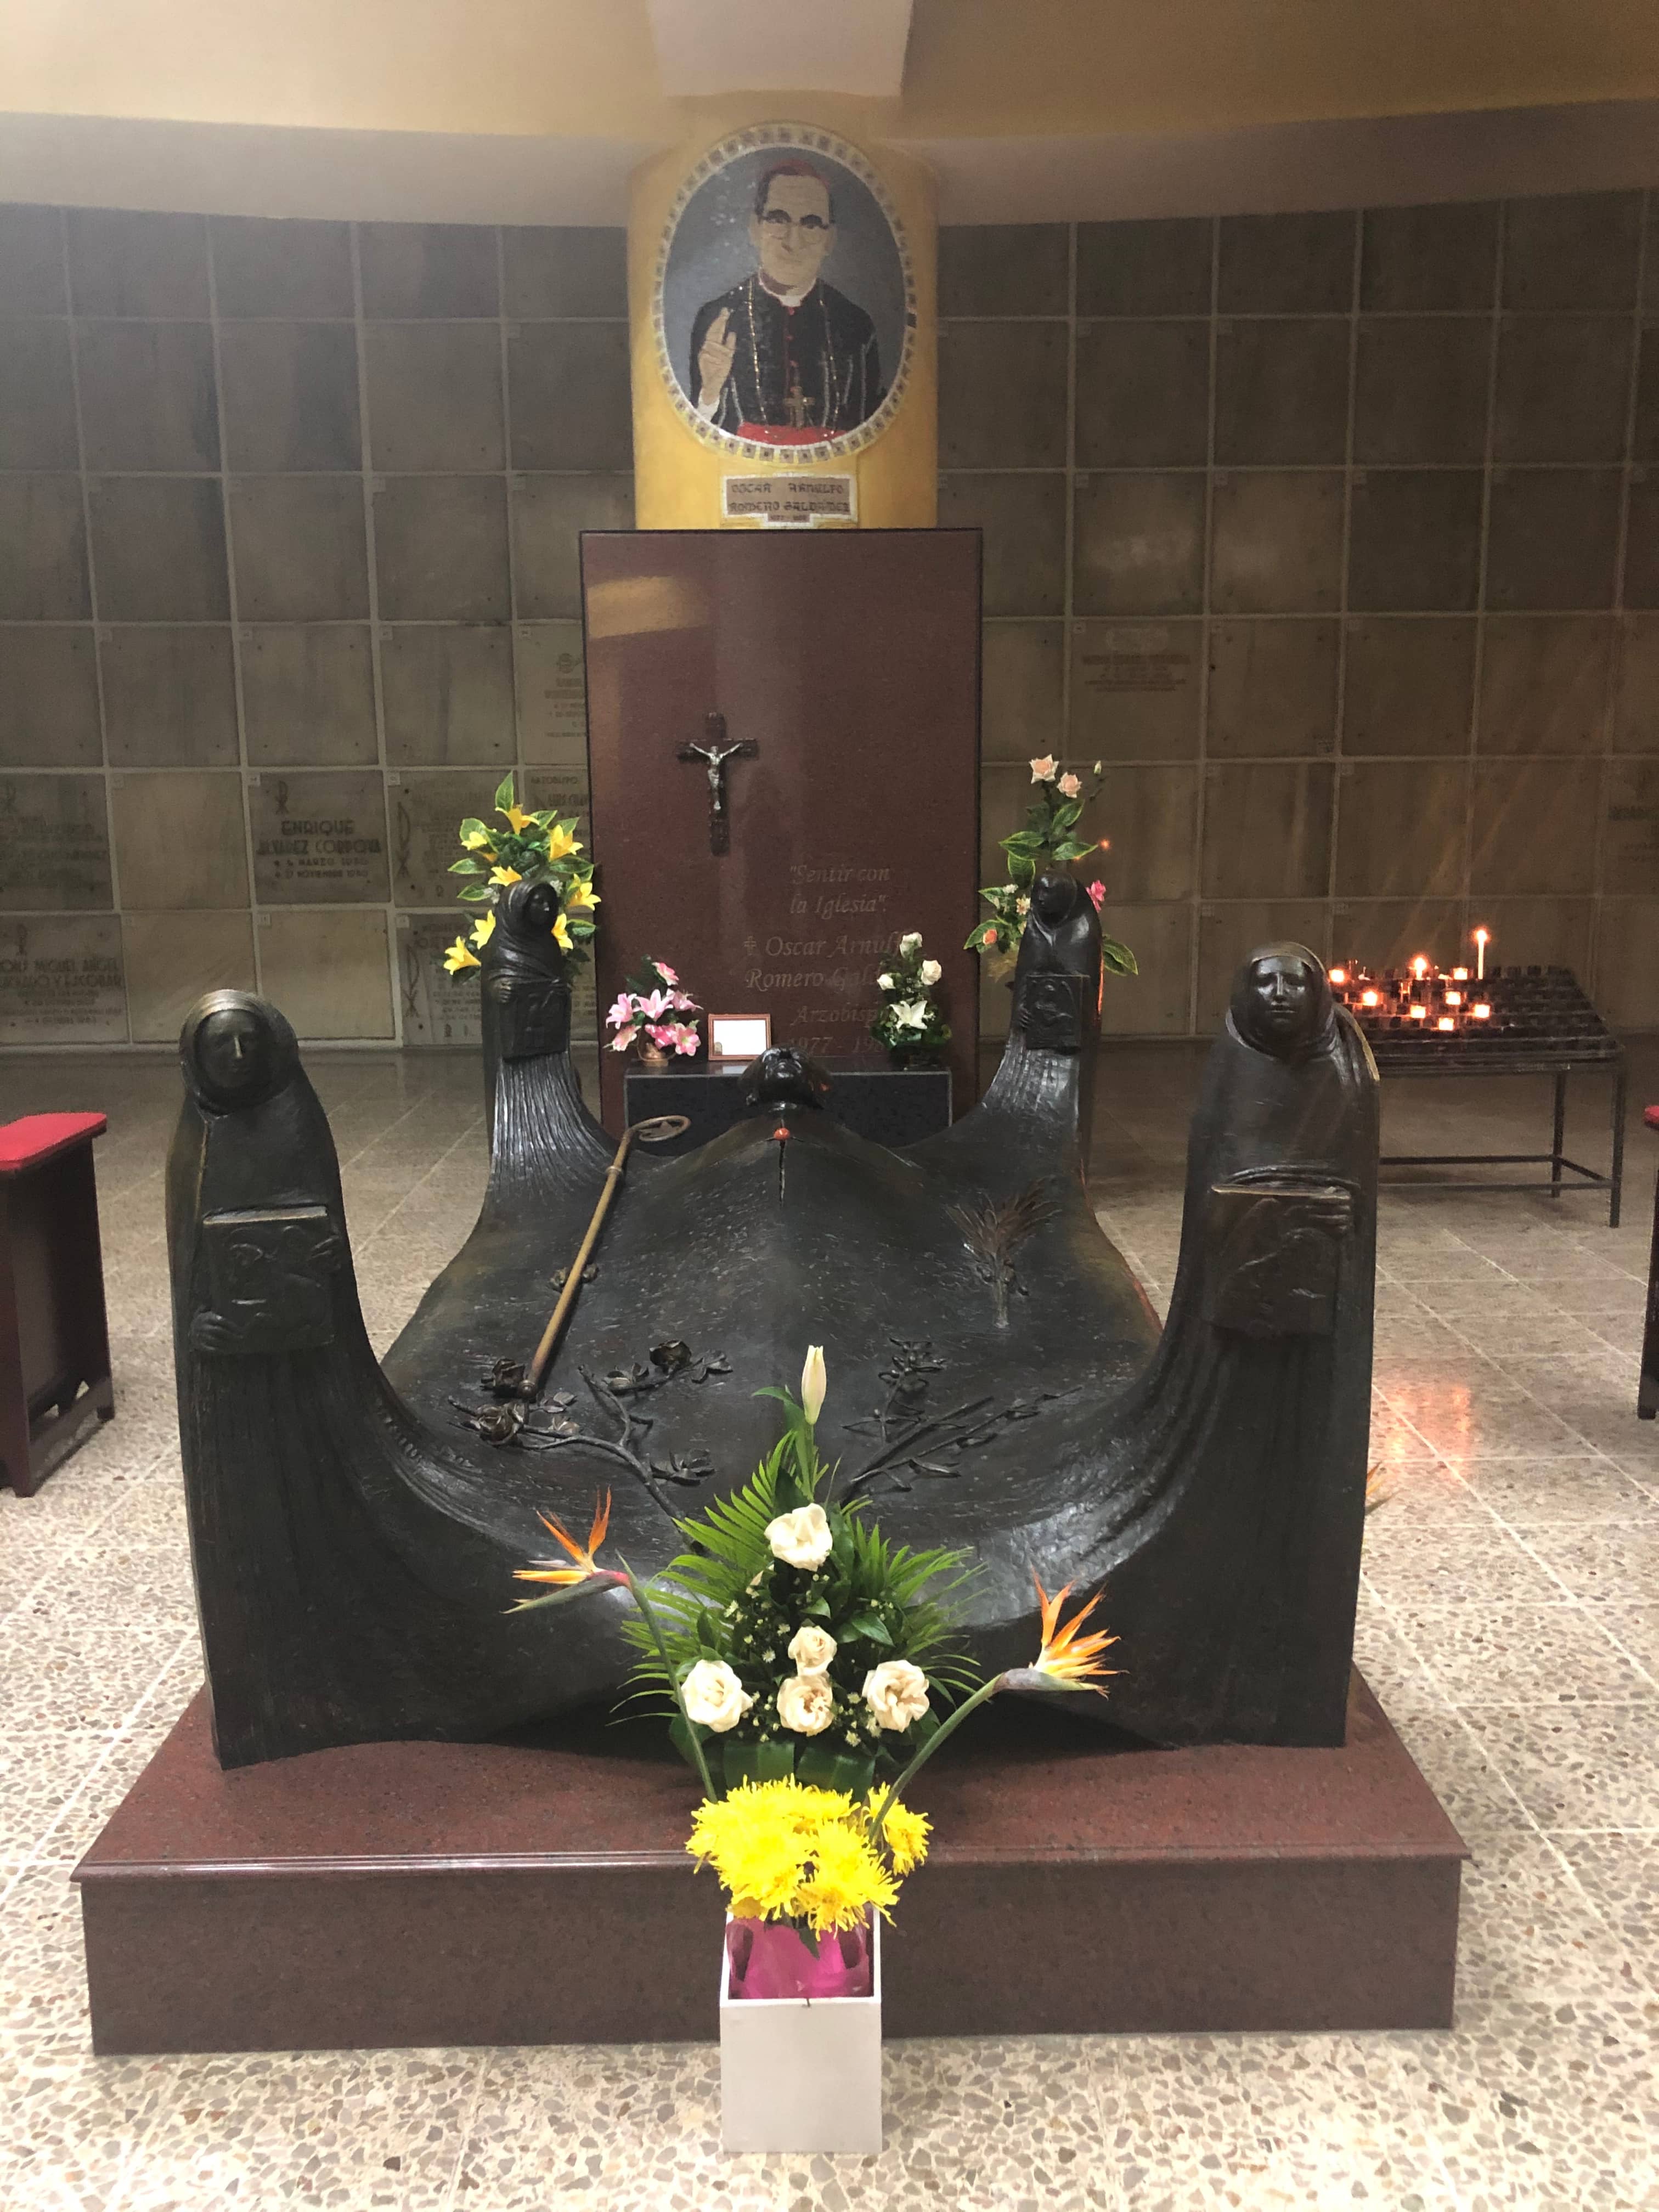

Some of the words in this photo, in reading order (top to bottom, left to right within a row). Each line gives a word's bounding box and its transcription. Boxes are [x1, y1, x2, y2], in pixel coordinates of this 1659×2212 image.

[731, 482, 772, 493] OSCAR
[857, 868, 890, 882] con
[790, 893, 808, 914] la
[765, 936, 827, 957] Oscar
[745, 968, 824, 992] Romero
